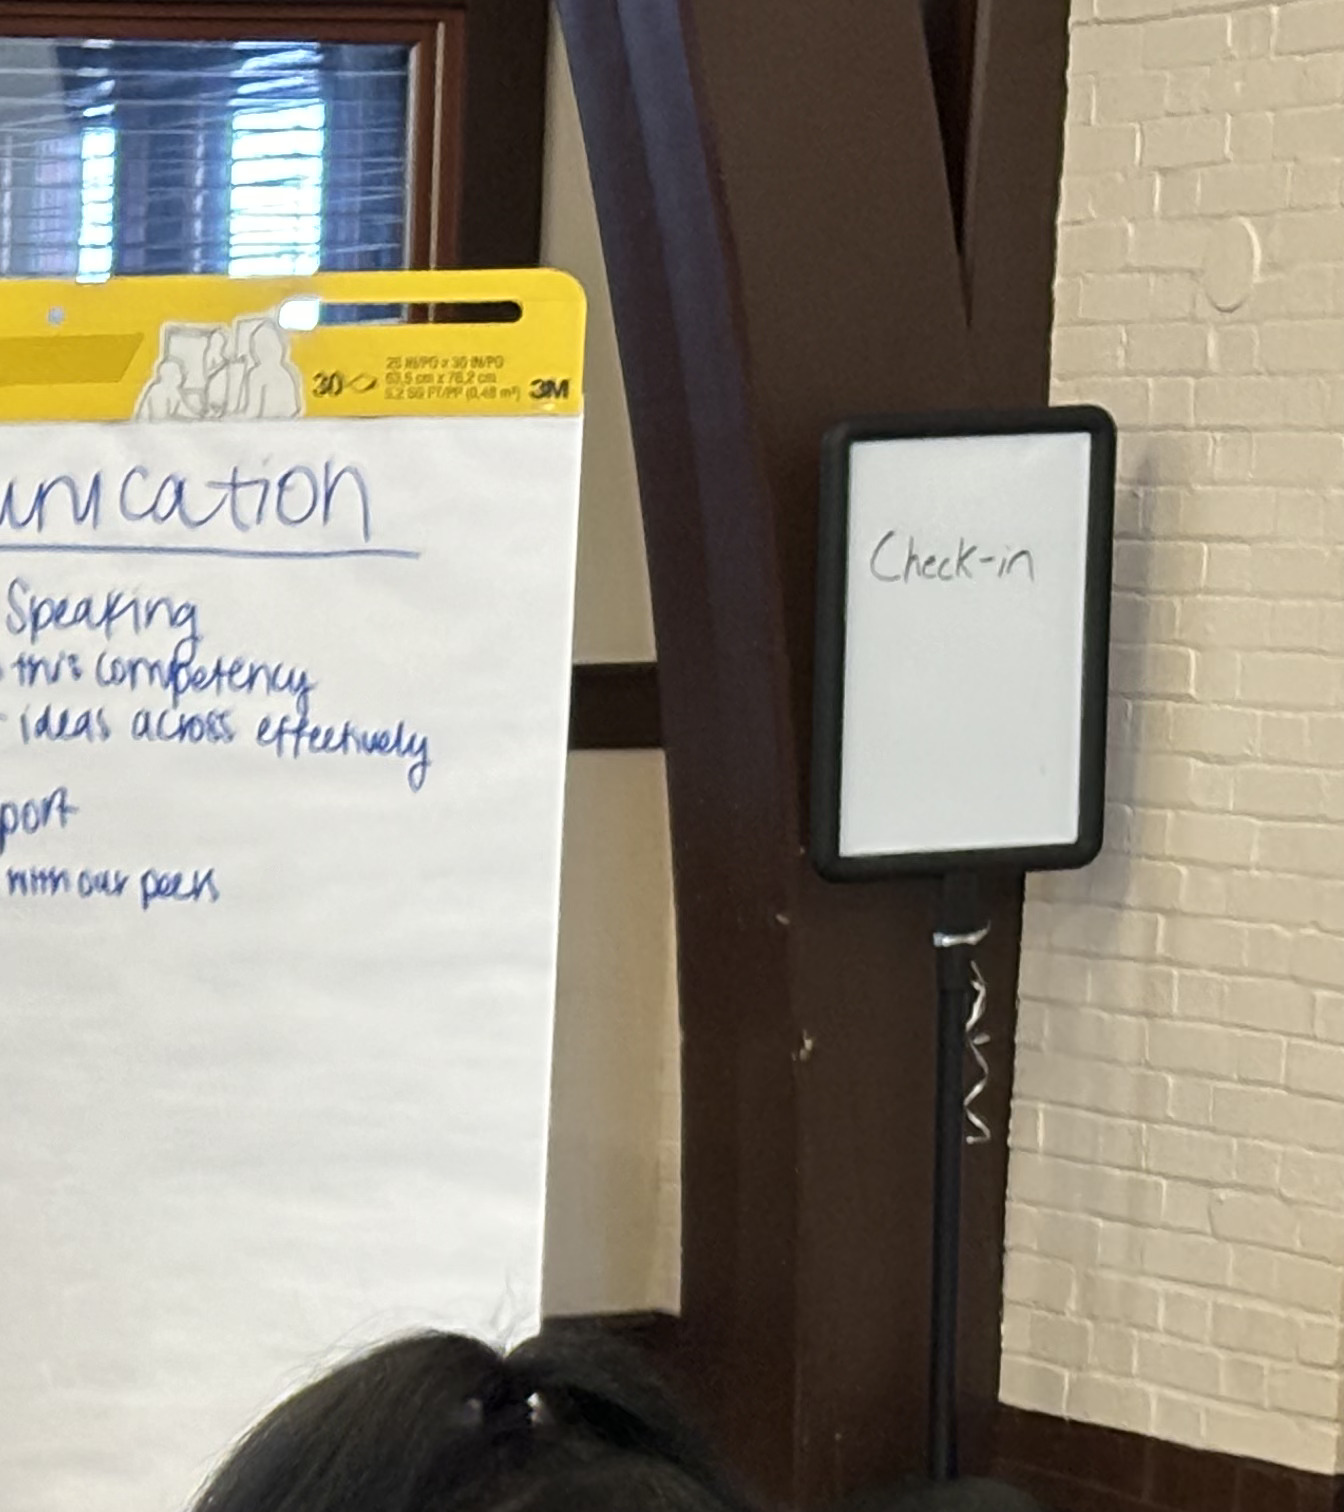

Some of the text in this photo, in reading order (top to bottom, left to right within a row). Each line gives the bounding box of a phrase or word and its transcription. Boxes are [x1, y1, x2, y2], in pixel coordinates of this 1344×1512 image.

[312, 371, 344, 398] 30
[528, 378, 570, 400] 3M
[869, 530, 1036, 583] Check-in
[11, 651, 83, 688] this
[19, 703, 111, 745] ideas
[131, 706, 238, 745] across
[255, 713, 432, 793] effectively
[6, 861, 73, 898] with
[75, 867, 129, 897] our
